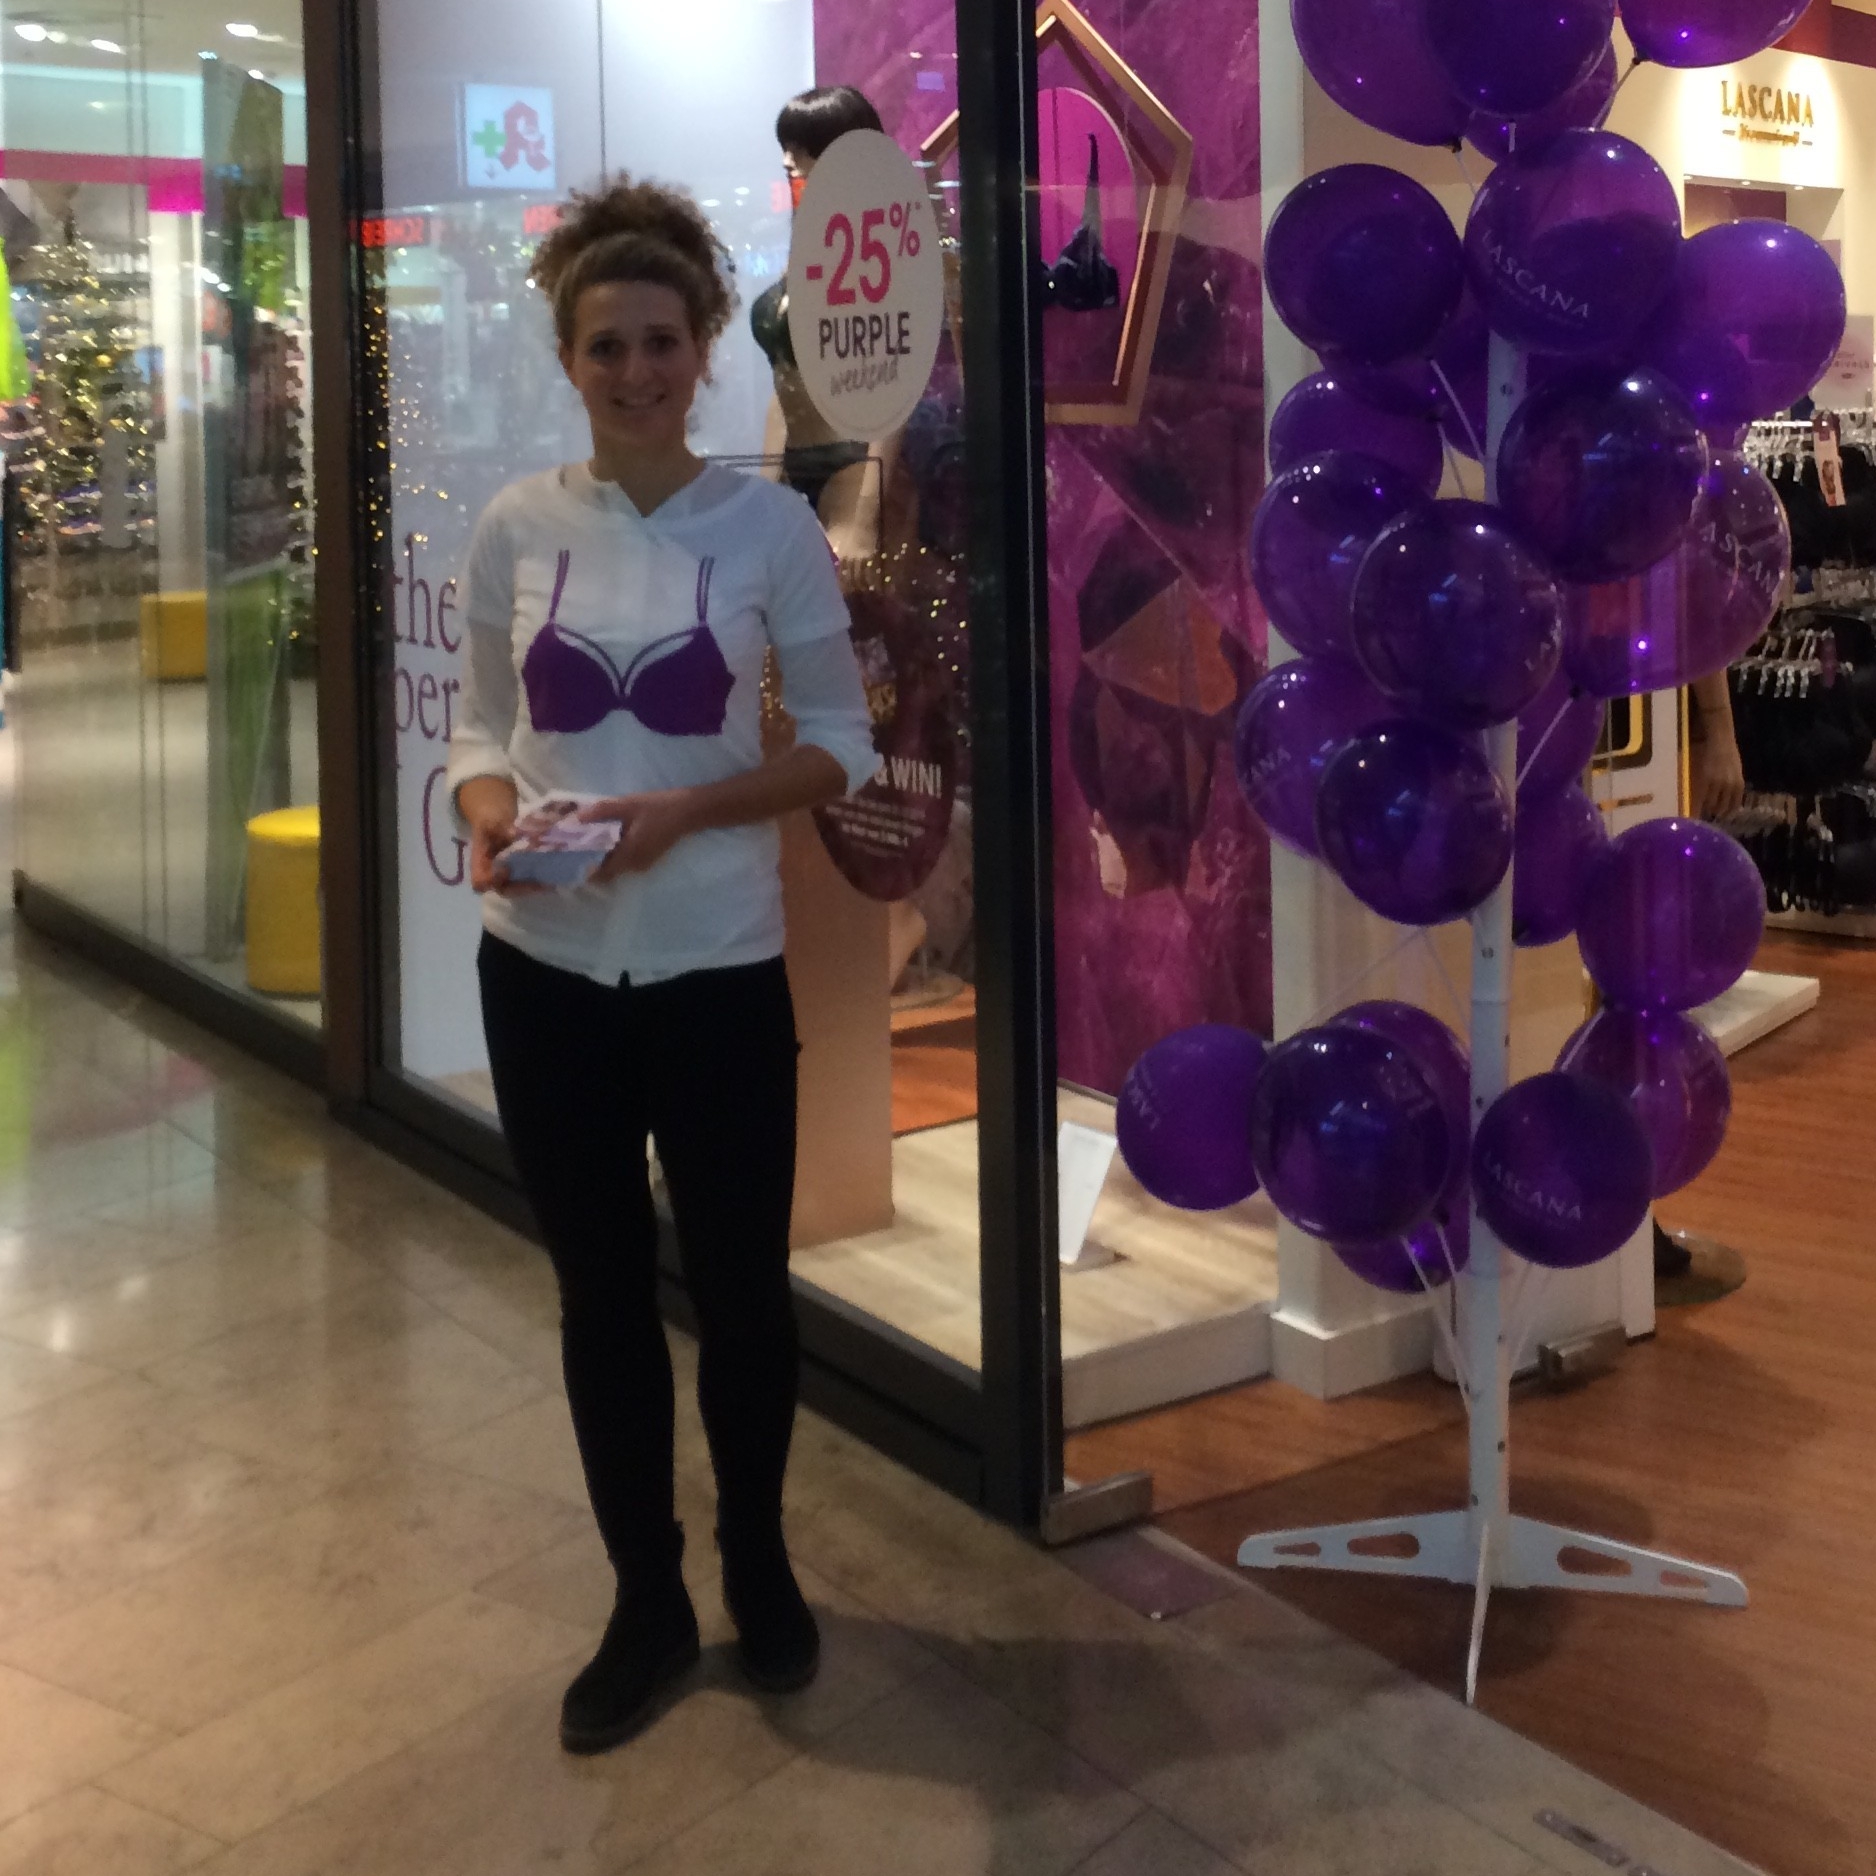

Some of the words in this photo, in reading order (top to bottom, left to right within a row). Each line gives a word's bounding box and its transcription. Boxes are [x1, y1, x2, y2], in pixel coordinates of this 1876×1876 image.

[1721, 80, 1814, 127] LASCANA
[1482, 229, 1588, 318] LASCANA
[819, 311, 911, 360] PURPLE
[392, 667, 461, 768] per
[890, 756, 943, 799] WIN!
[422, 765, 469, 886] G
